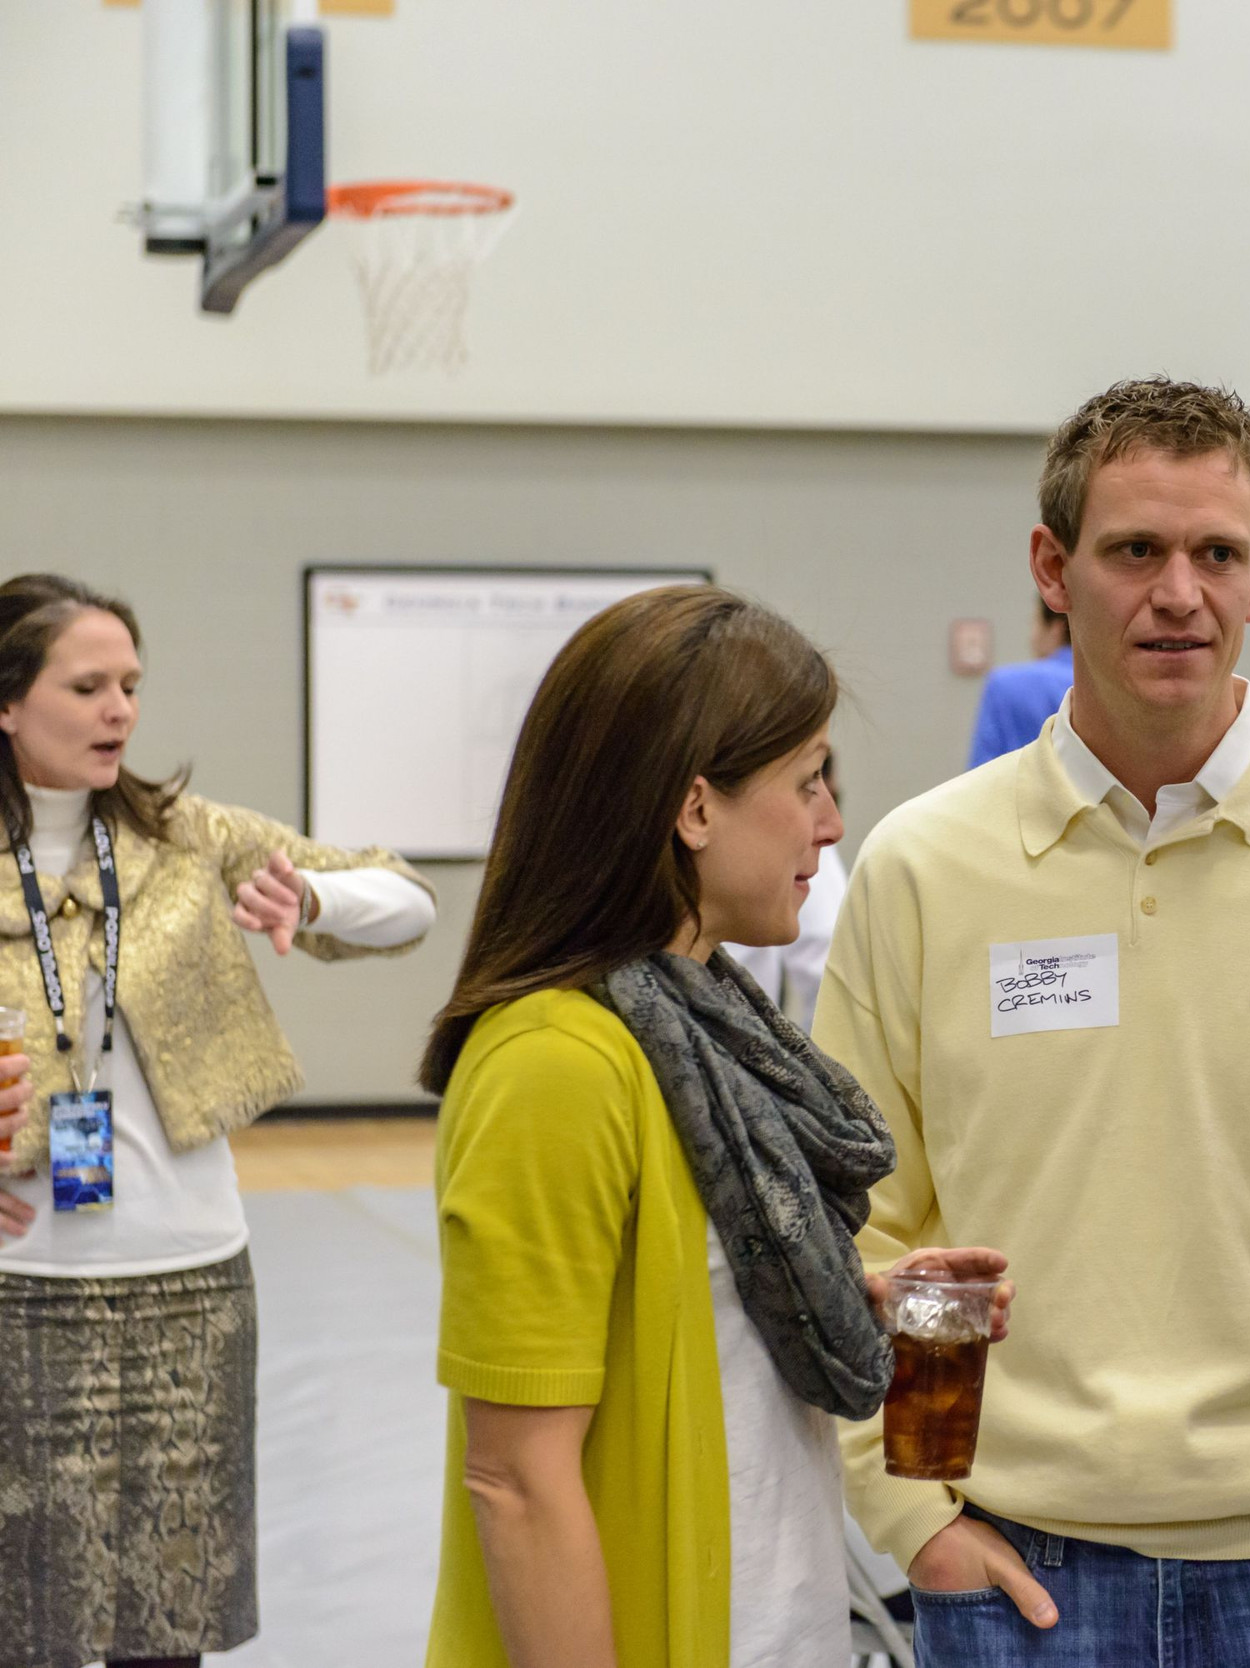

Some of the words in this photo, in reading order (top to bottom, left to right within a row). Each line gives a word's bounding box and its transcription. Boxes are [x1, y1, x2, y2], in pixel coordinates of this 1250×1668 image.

[950, 0, 1137, 31] 2007
[1026, 956, 1060, 966] Georgia
[996, 971, 1067, 993] BOBBY
[997, 989, 1091, 1012] CREMINS
